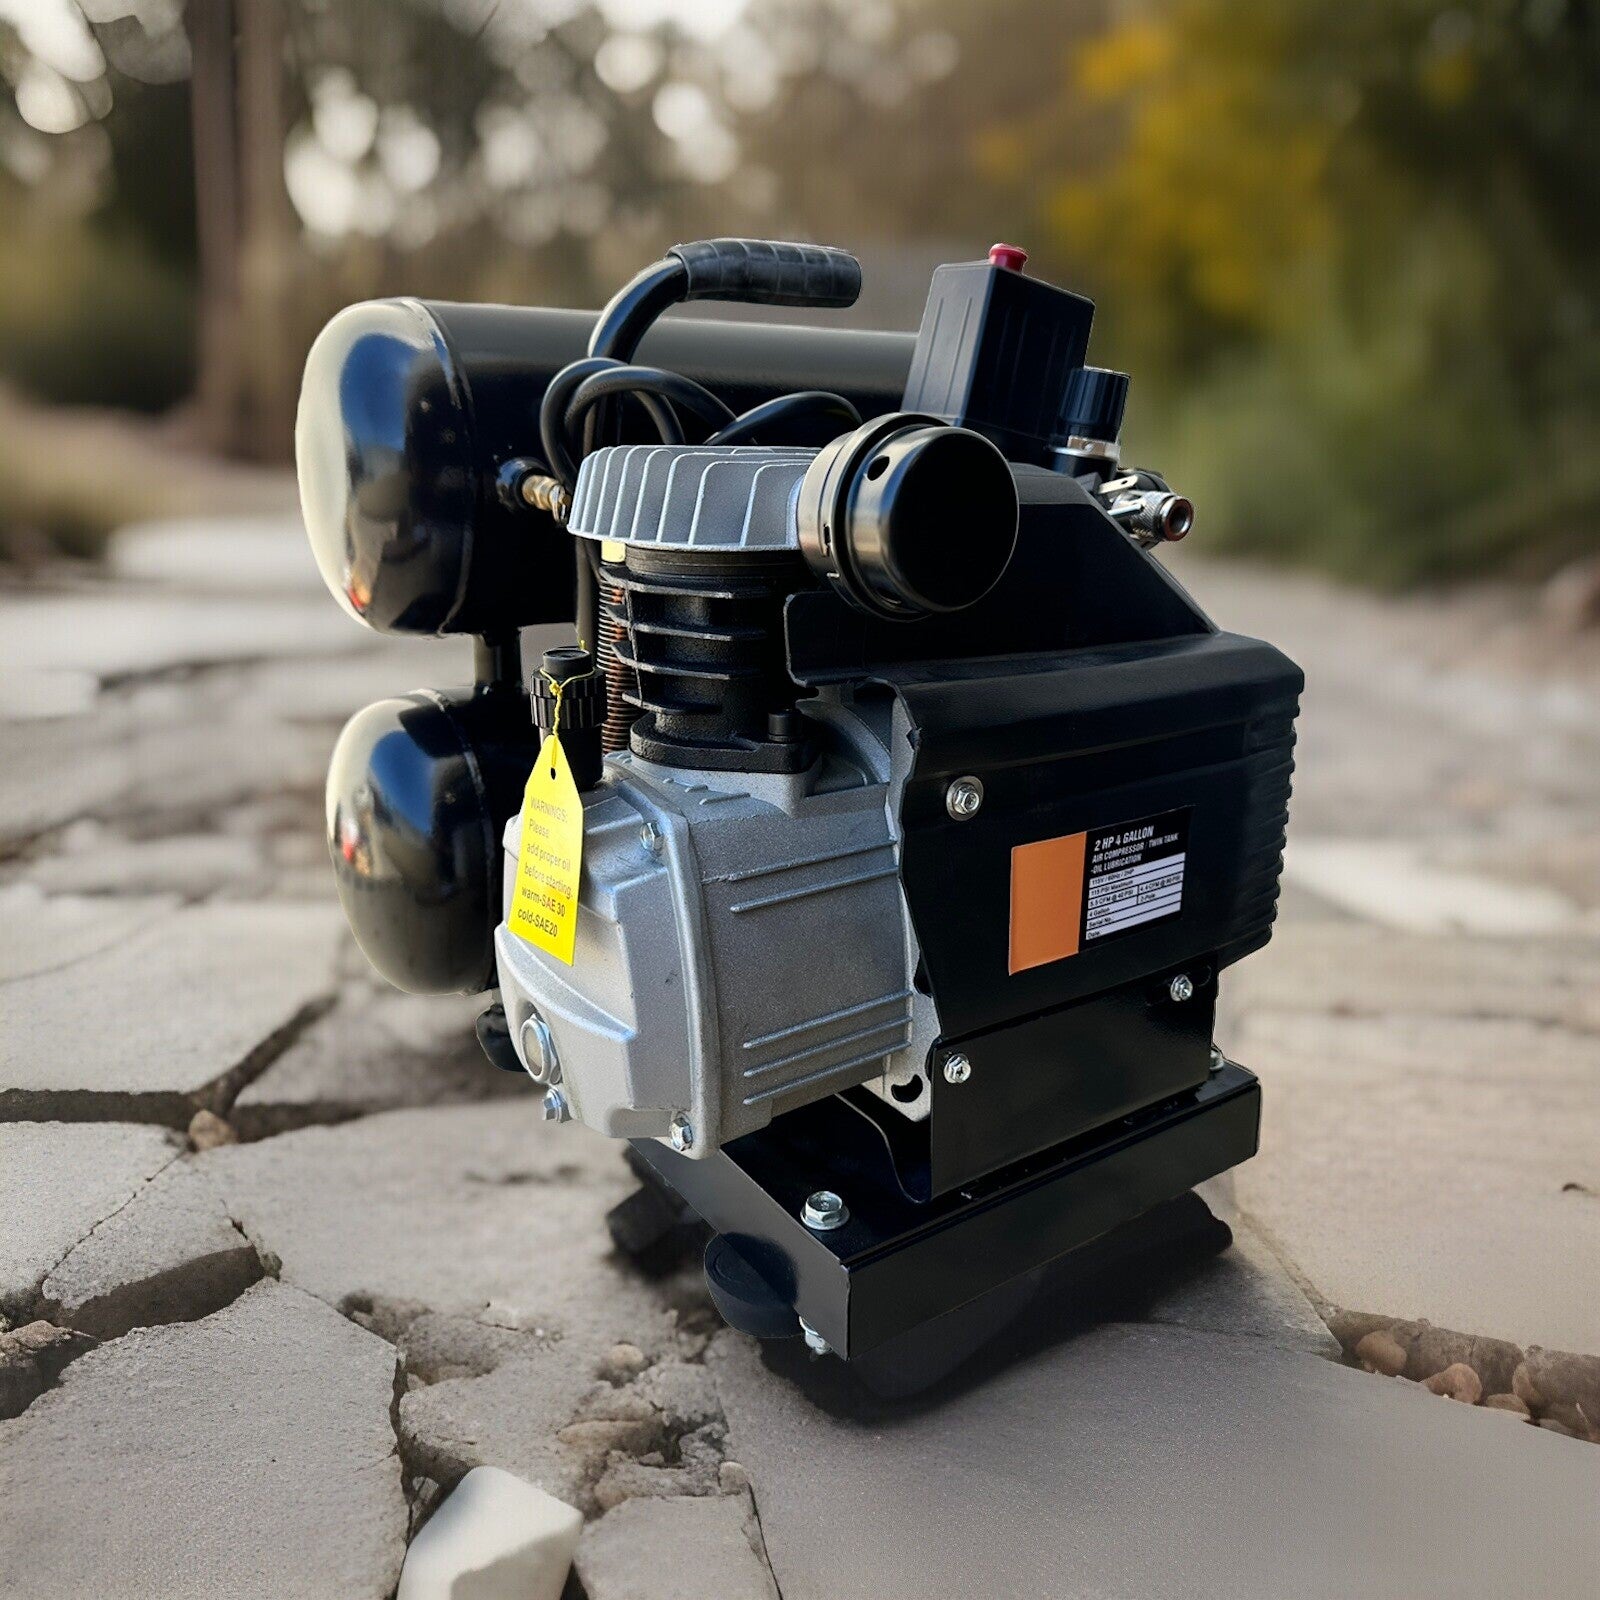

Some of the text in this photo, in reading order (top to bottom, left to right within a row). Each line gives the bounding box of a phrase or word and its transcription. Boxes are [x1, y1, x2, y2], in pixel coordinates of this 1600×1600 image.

[529, 818, 550, 838] Please
[1094, 825, 1155, 852] 2 HP 4 GALLON
[527, 843, 571, 872] add proper oil
[1092, 853, 1103, 864] AIR
[1104, 842, 1145, 860] COMPRESSOR
[1149, 836, 1163, 848] TWIN
[1163, 832, 1179, 844] TANK
[524, 862, 545, 883] before
[1103, 853, 1142, 872] LUBRICATION
[1098, 896, 1111, 906] CFM
[1124, 889, 1134, 897] PSI
[1100, 886, 1110, 894] PSI
[1110, 880, 1134, 890] Maximum
[522, 887, 566, 917] warm-SAE 30
[517, 908, 558, 937] cold-SAE20
